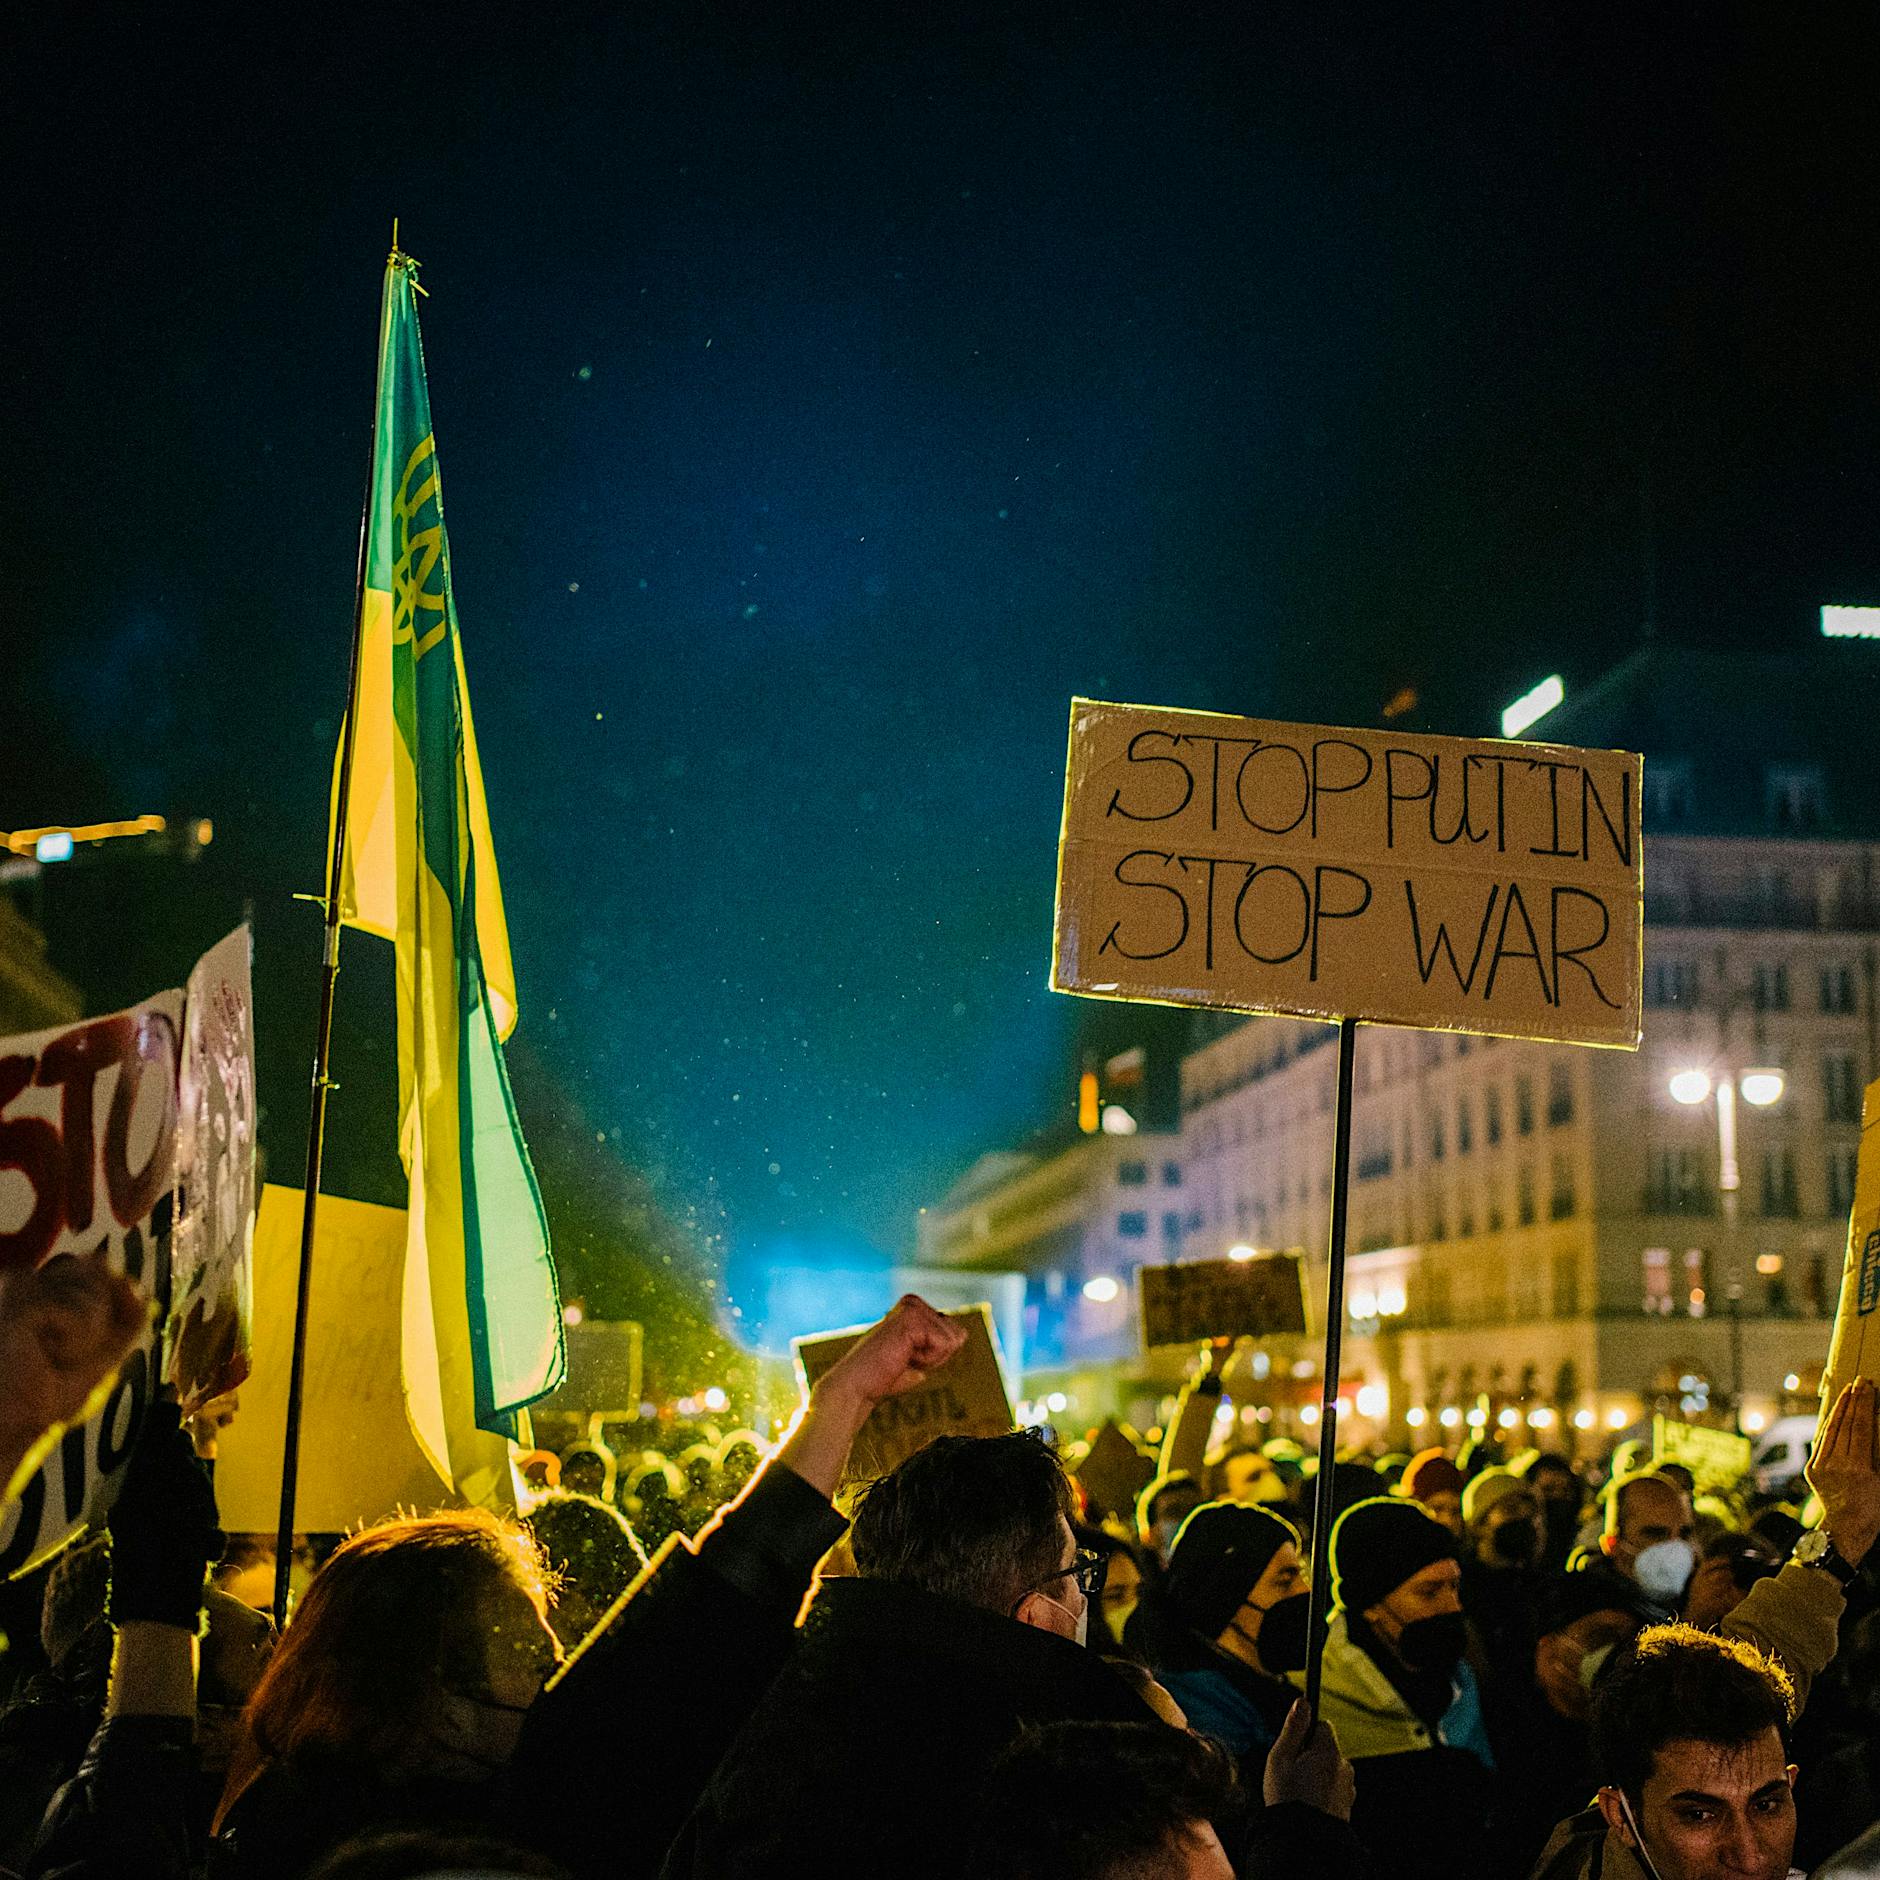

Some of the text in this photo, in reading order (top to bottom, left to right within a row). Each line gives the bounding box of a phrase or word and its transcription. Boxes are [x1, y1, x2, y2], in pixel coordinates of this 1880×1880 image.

[1105, 729, 1632, 867] STOP PUTIN
[1098, 849, 1622, 1010] STOP WAR
